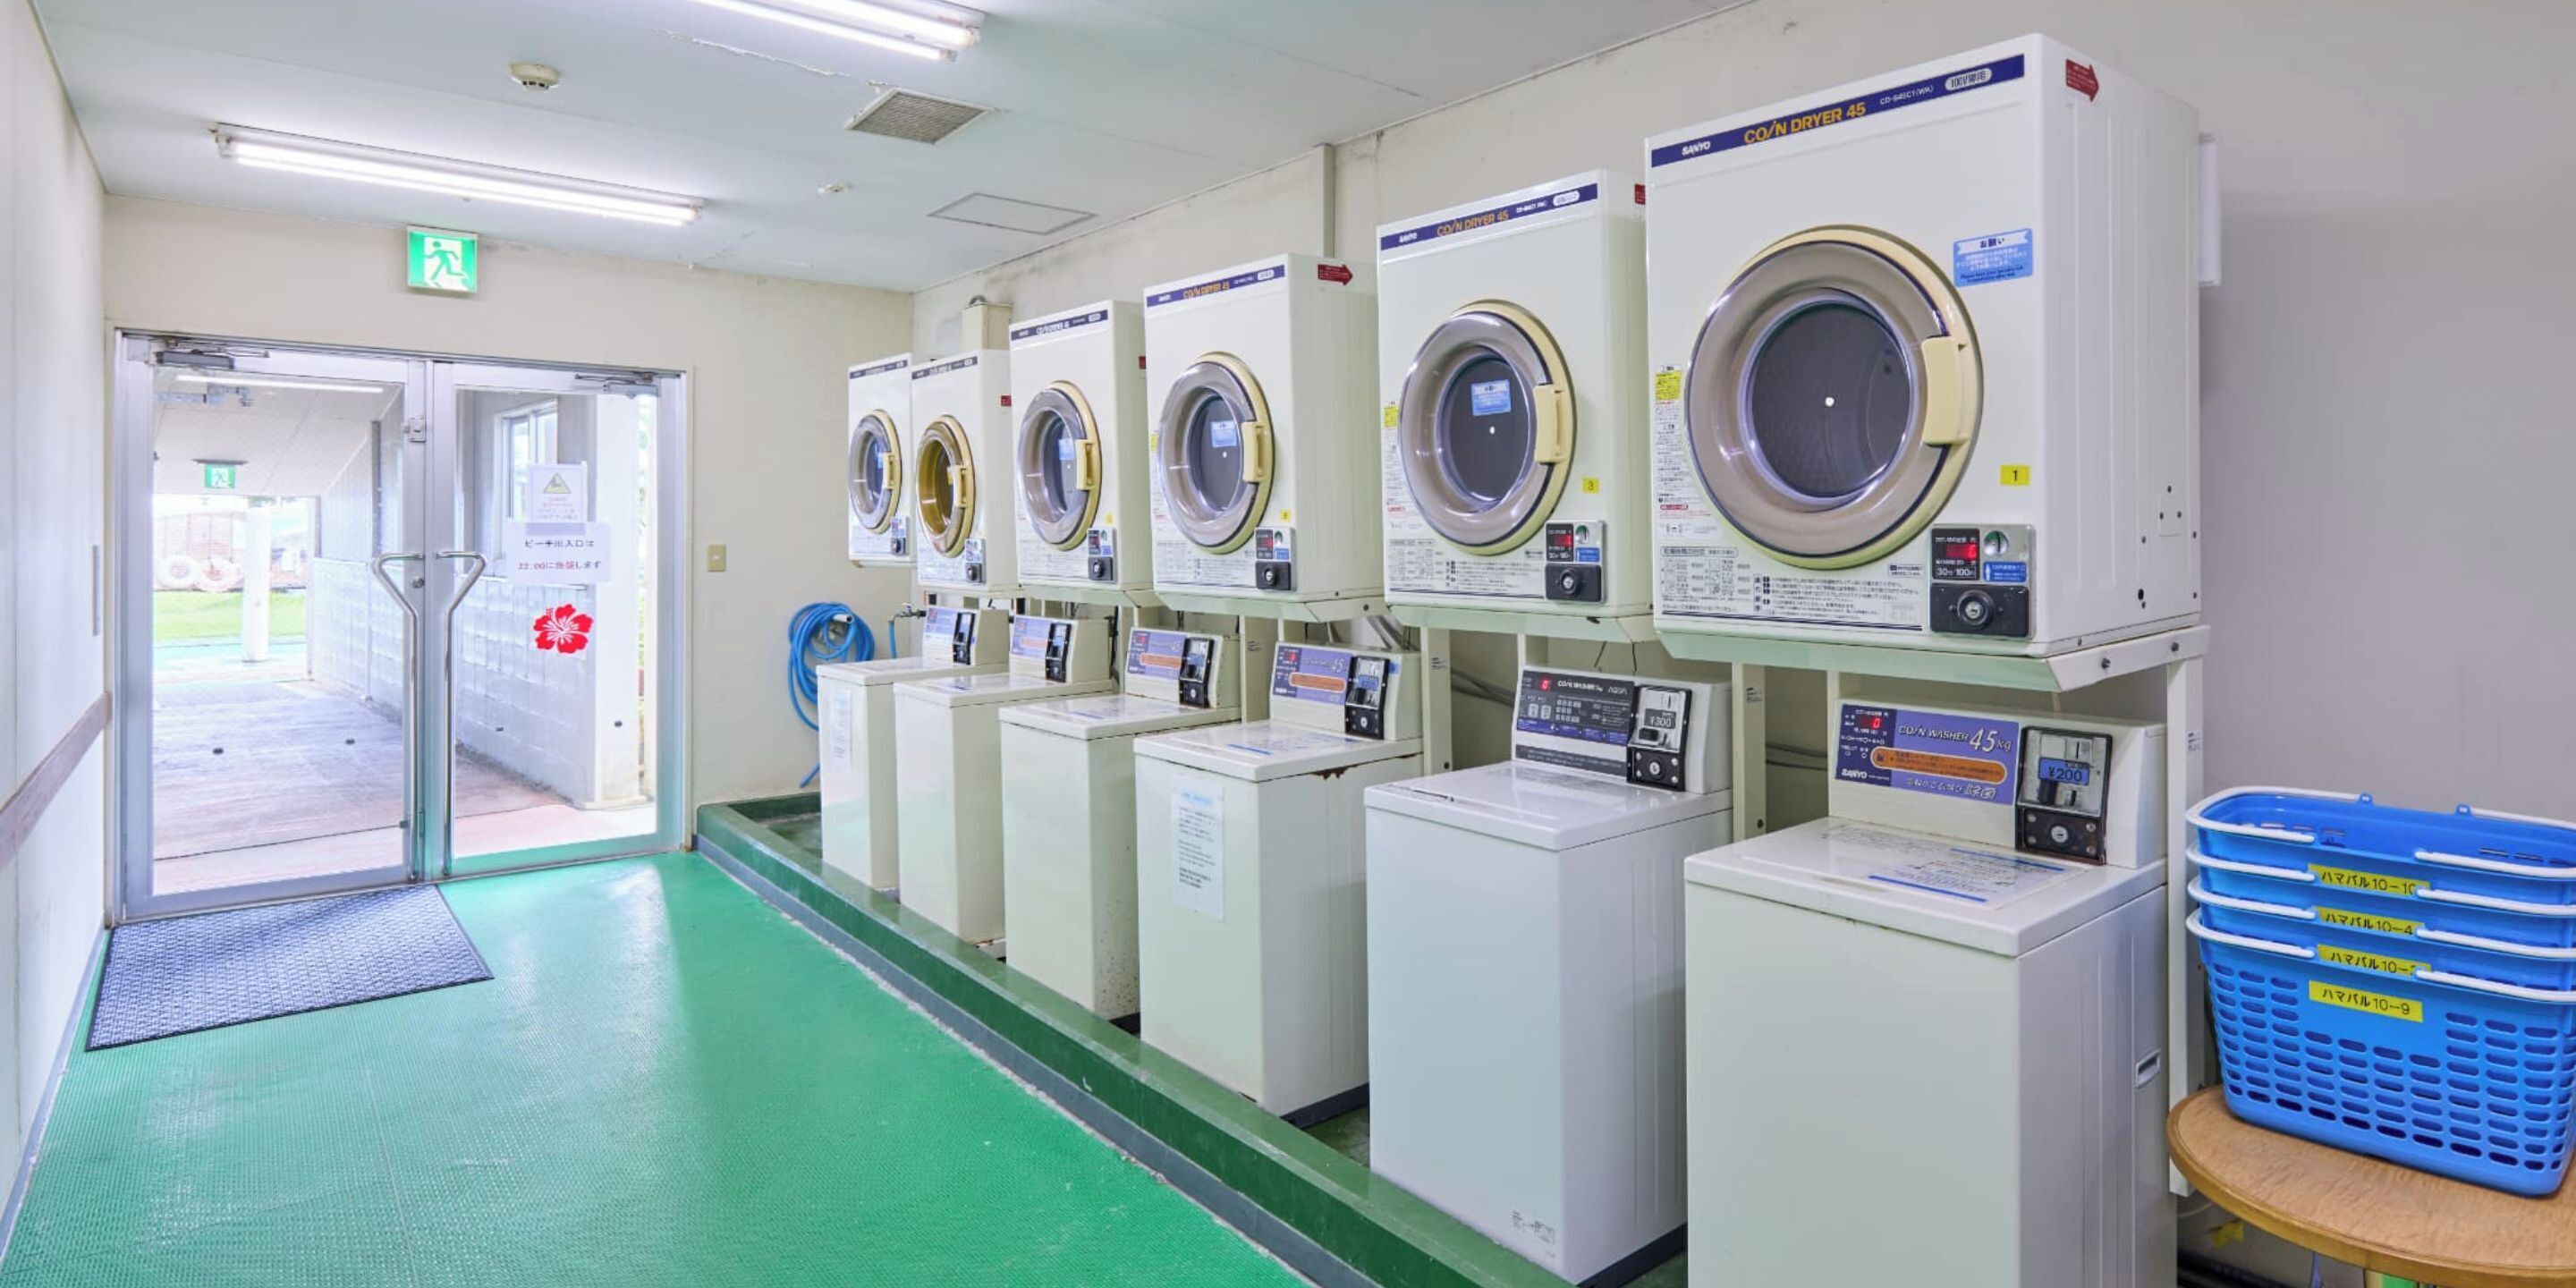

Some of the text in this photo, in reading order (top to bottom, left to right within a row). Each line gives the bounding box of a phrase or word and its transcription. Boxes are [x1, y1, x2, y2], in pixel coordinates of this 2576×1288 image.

[1791, 108, 1843, 132] DRYER
[1846, 102, 1867, 118] 45
[1682, 140, 1711, 157] SANYO
[1464, 214, 1495, 230] DRYER
[1497, 209, 1509, 222] 45
[2012, 469, 2018, 482] 1
[525, 538, 595, 548] ビーチ出入口は
[1928, 730, 1969, 742] WASHER
[1842, 767, 1868, 780] SANYO
[2048, 767, 2082, 783] ¥200
